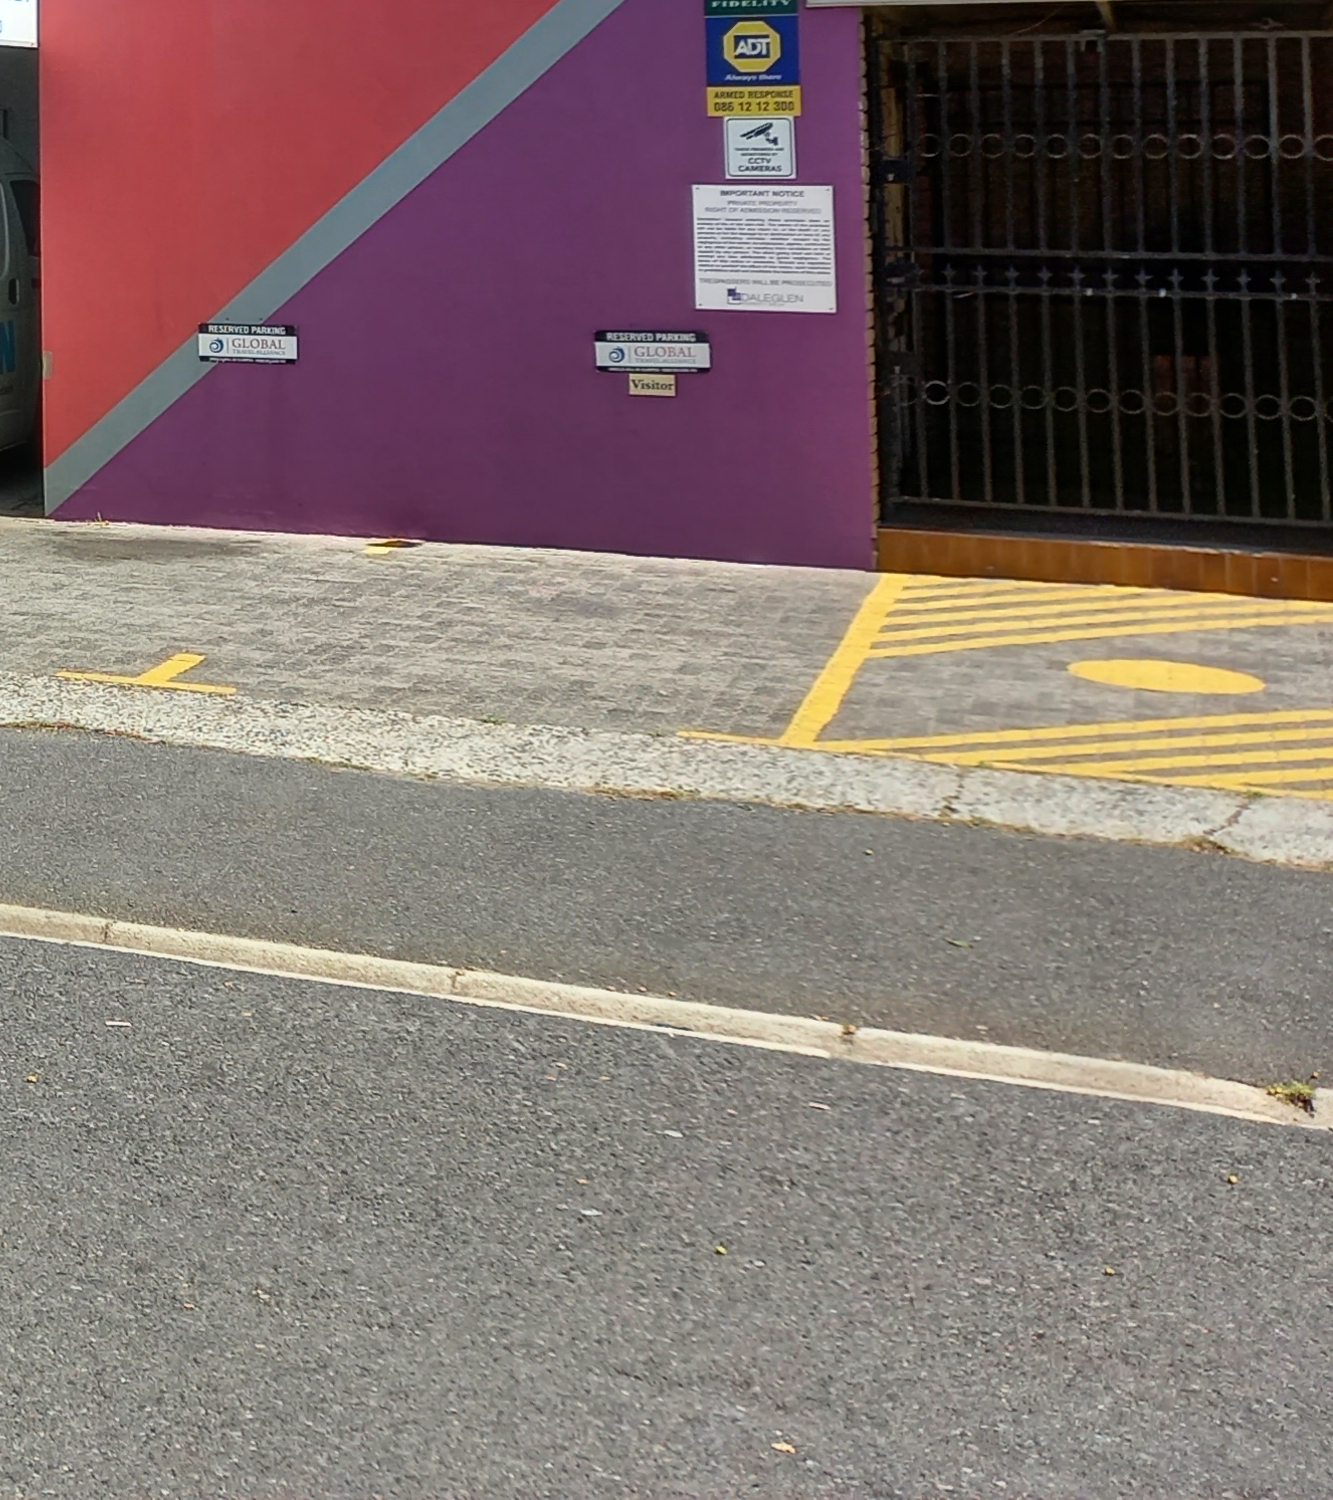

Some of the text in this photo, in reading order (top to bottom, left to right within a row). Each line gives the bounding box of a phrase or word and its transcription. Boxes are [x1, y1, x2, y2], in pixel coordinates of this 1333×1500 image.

[734, 38, 771, 56] ADT
[714, 90, 793, 99] ARMED RESPONSE
[738, 102, 752, 112] 12
[756, 101, 769, 111] 12
[741, 293, 804, 303] DALEGLEN
[208, 325, 286, 335] RESERVED PARKING
[606, 332, 696, 342] RESERVED PARKING
[232, 338, 286, 349] GLOBAL
[634, 346, 697, 358] GLOBAL
[631, 379, 674, 390] Visitor
